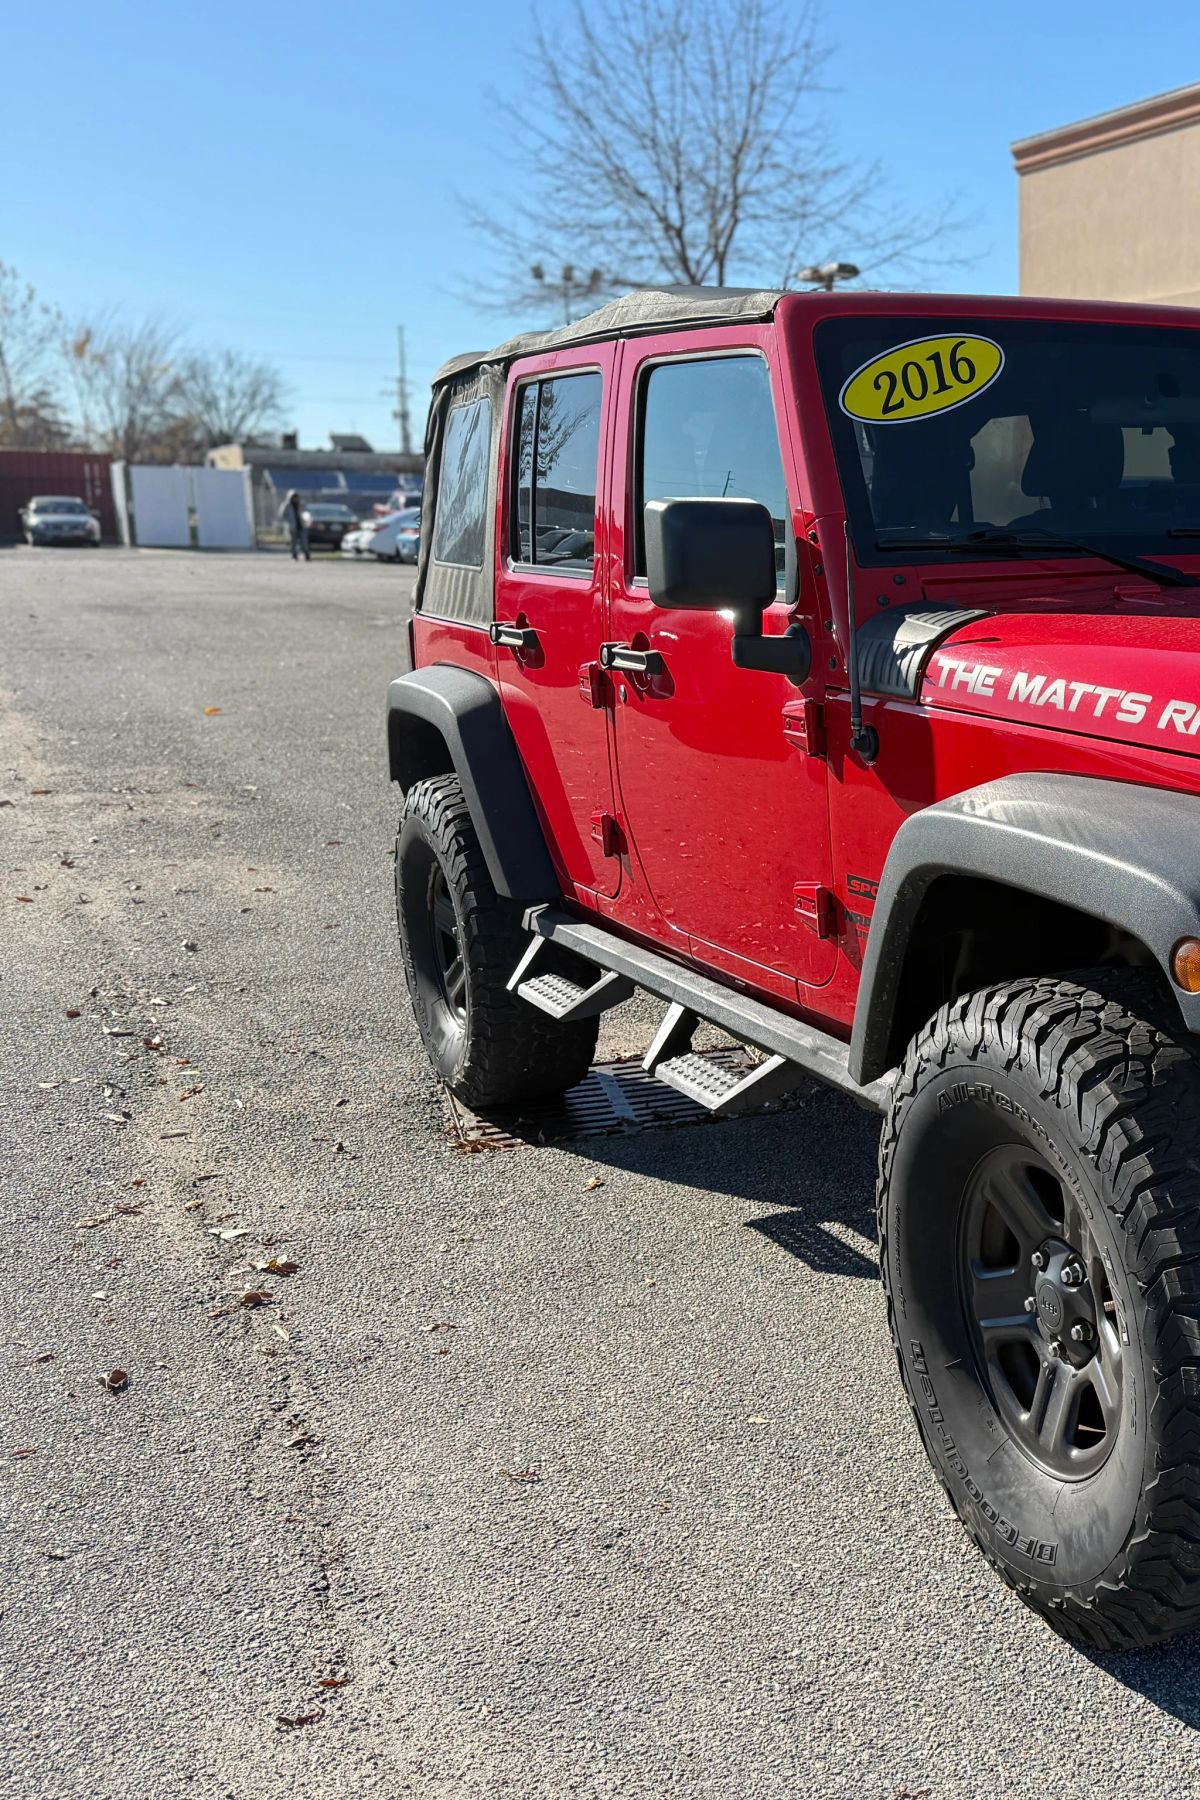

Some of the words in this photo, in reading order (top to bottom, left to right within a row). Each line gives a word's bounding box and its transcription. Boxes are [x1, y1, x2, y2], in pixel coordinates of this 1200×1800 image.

[873, 340, 976, 415] 2016
[936, 659, 1003, 697] THE
[1007, 671, 1152, 724] MATT'S
[1041, 1295, 1058, 1317] Jeep
